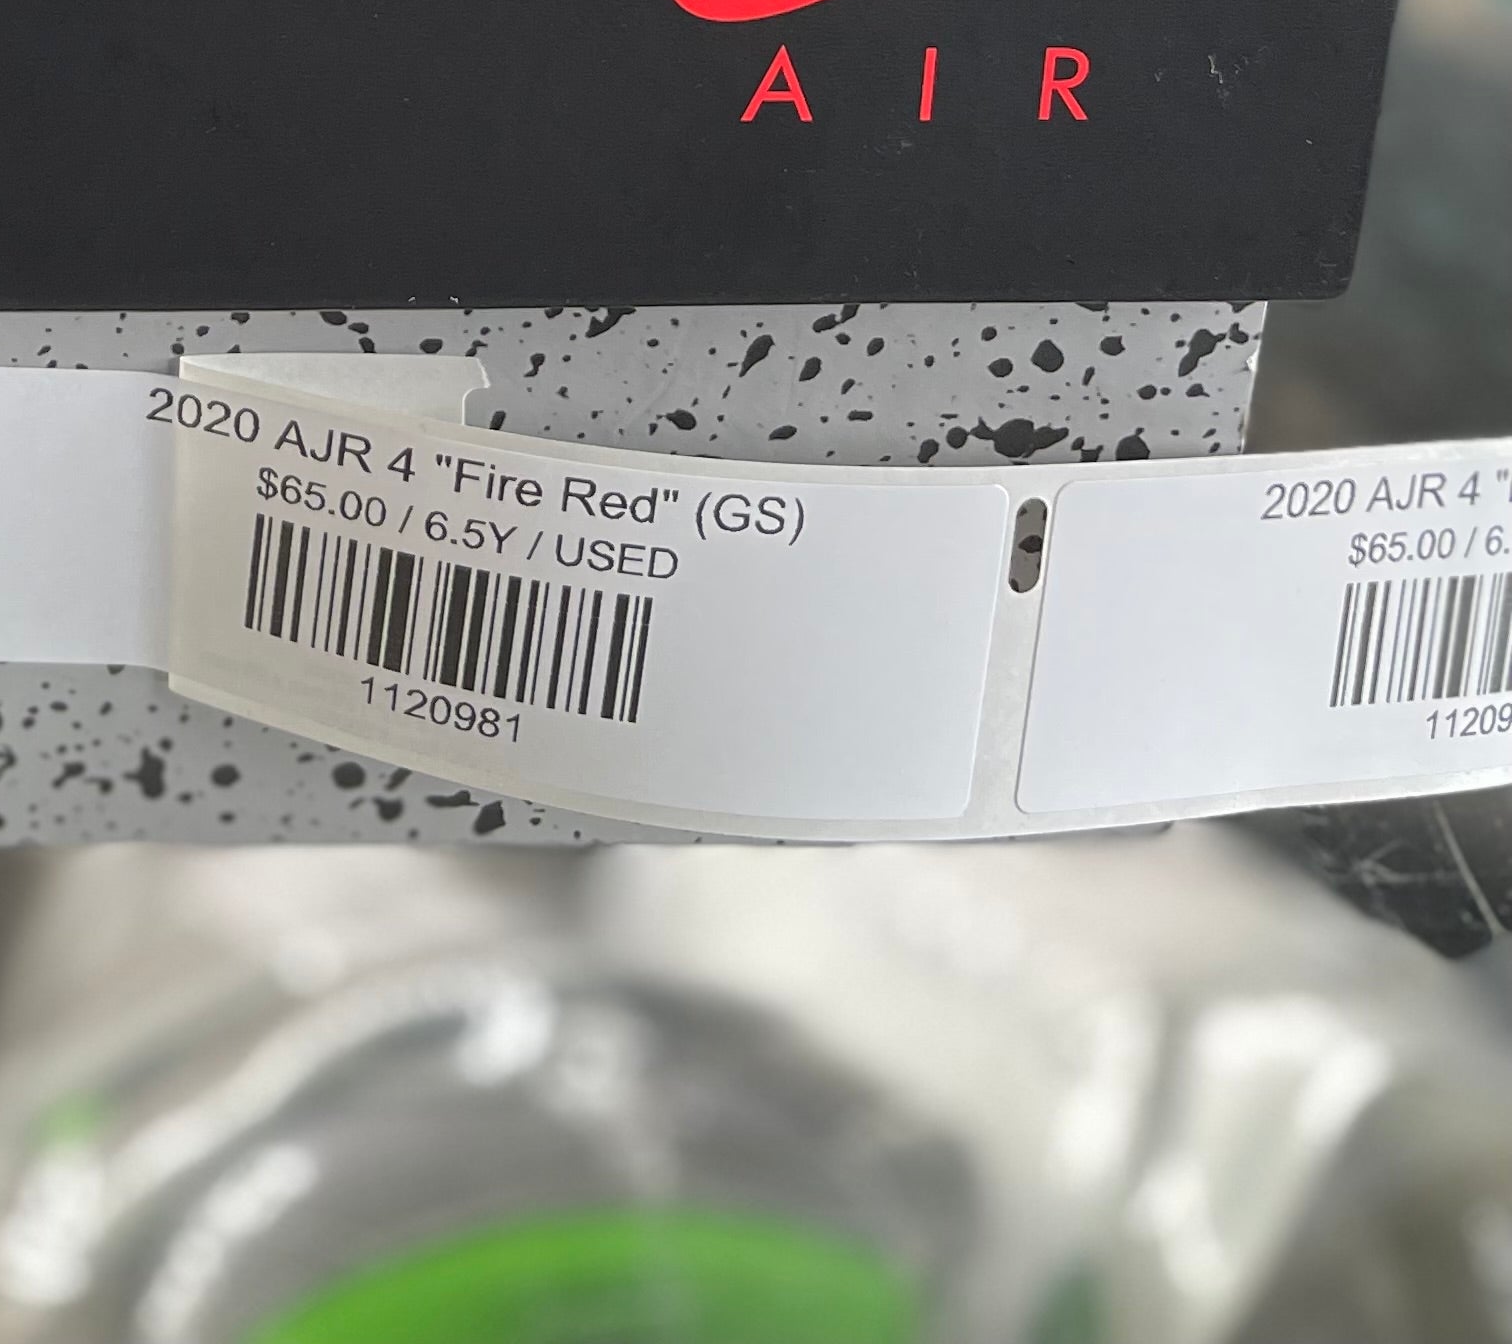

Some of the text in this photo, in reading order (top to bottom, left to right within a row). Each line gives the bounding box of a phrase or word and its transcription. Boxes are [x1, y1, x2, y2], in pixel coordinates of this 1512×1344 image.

[146, 387, 805, 545] 2020 AJR 4 "Fire Red" (GS)
[1261, 478, 1354, 519] 2020
[1365, 472, 1446, 512] AJR
[1457, 471, 1480, 506] 4
[256, 467, 679, 580] $65.00 / 6.5Y / USED
[1348, 527, 1455, 567] $65.00
[361, 677, 522, 743] 1120981
